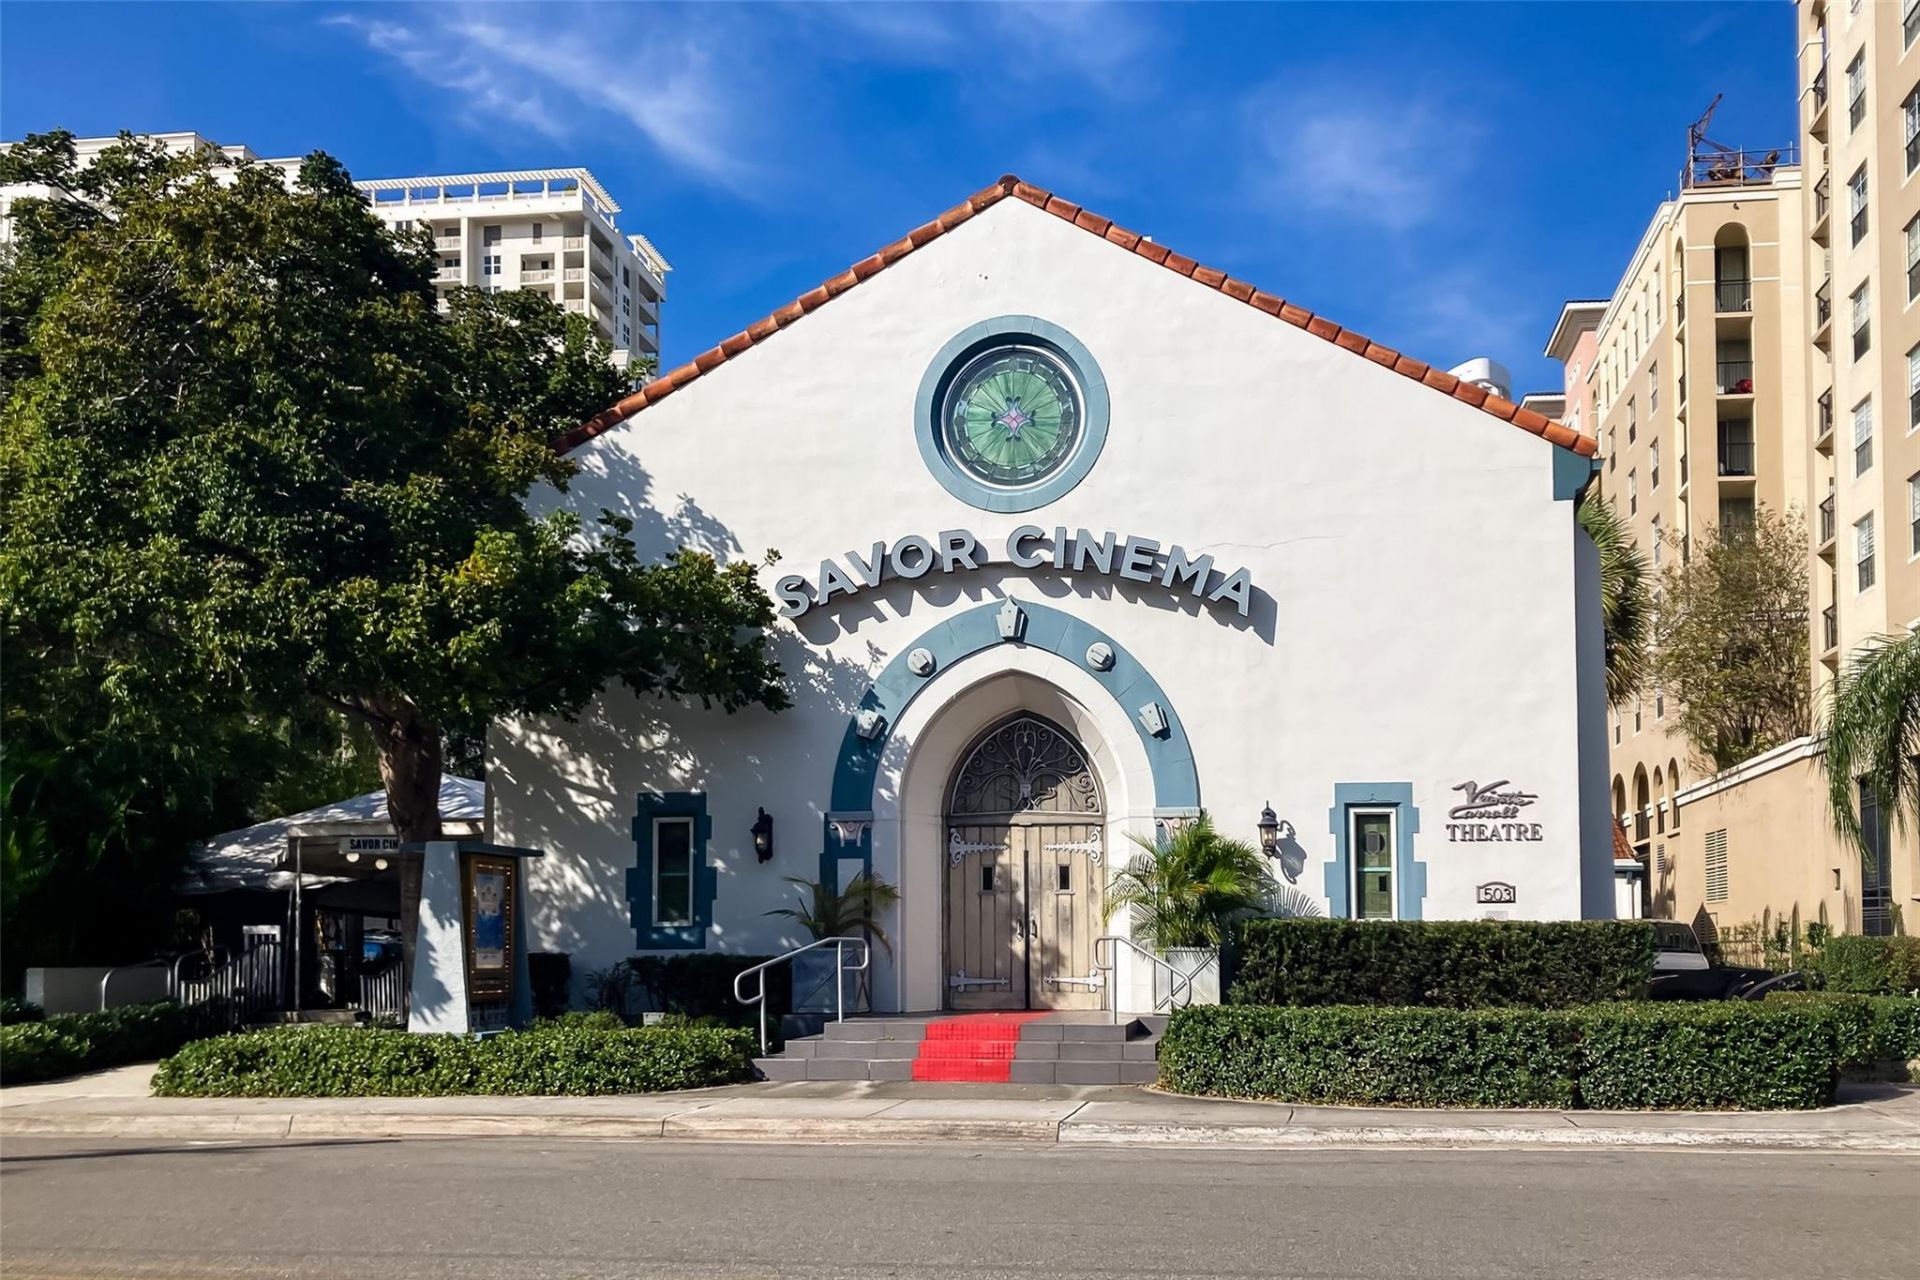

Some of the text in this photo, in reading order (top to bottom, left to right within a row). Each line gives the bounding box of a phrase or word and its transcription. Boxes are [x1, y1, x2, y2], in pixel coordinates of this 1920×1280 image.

[775, 525, 1252, 618] SAVOR CINEMA
[1446, 823, 1544, 842] THEATRE
[350, 838, 399, 850] SAVOR CIN
[1484, 888, 1512, 901] 503
